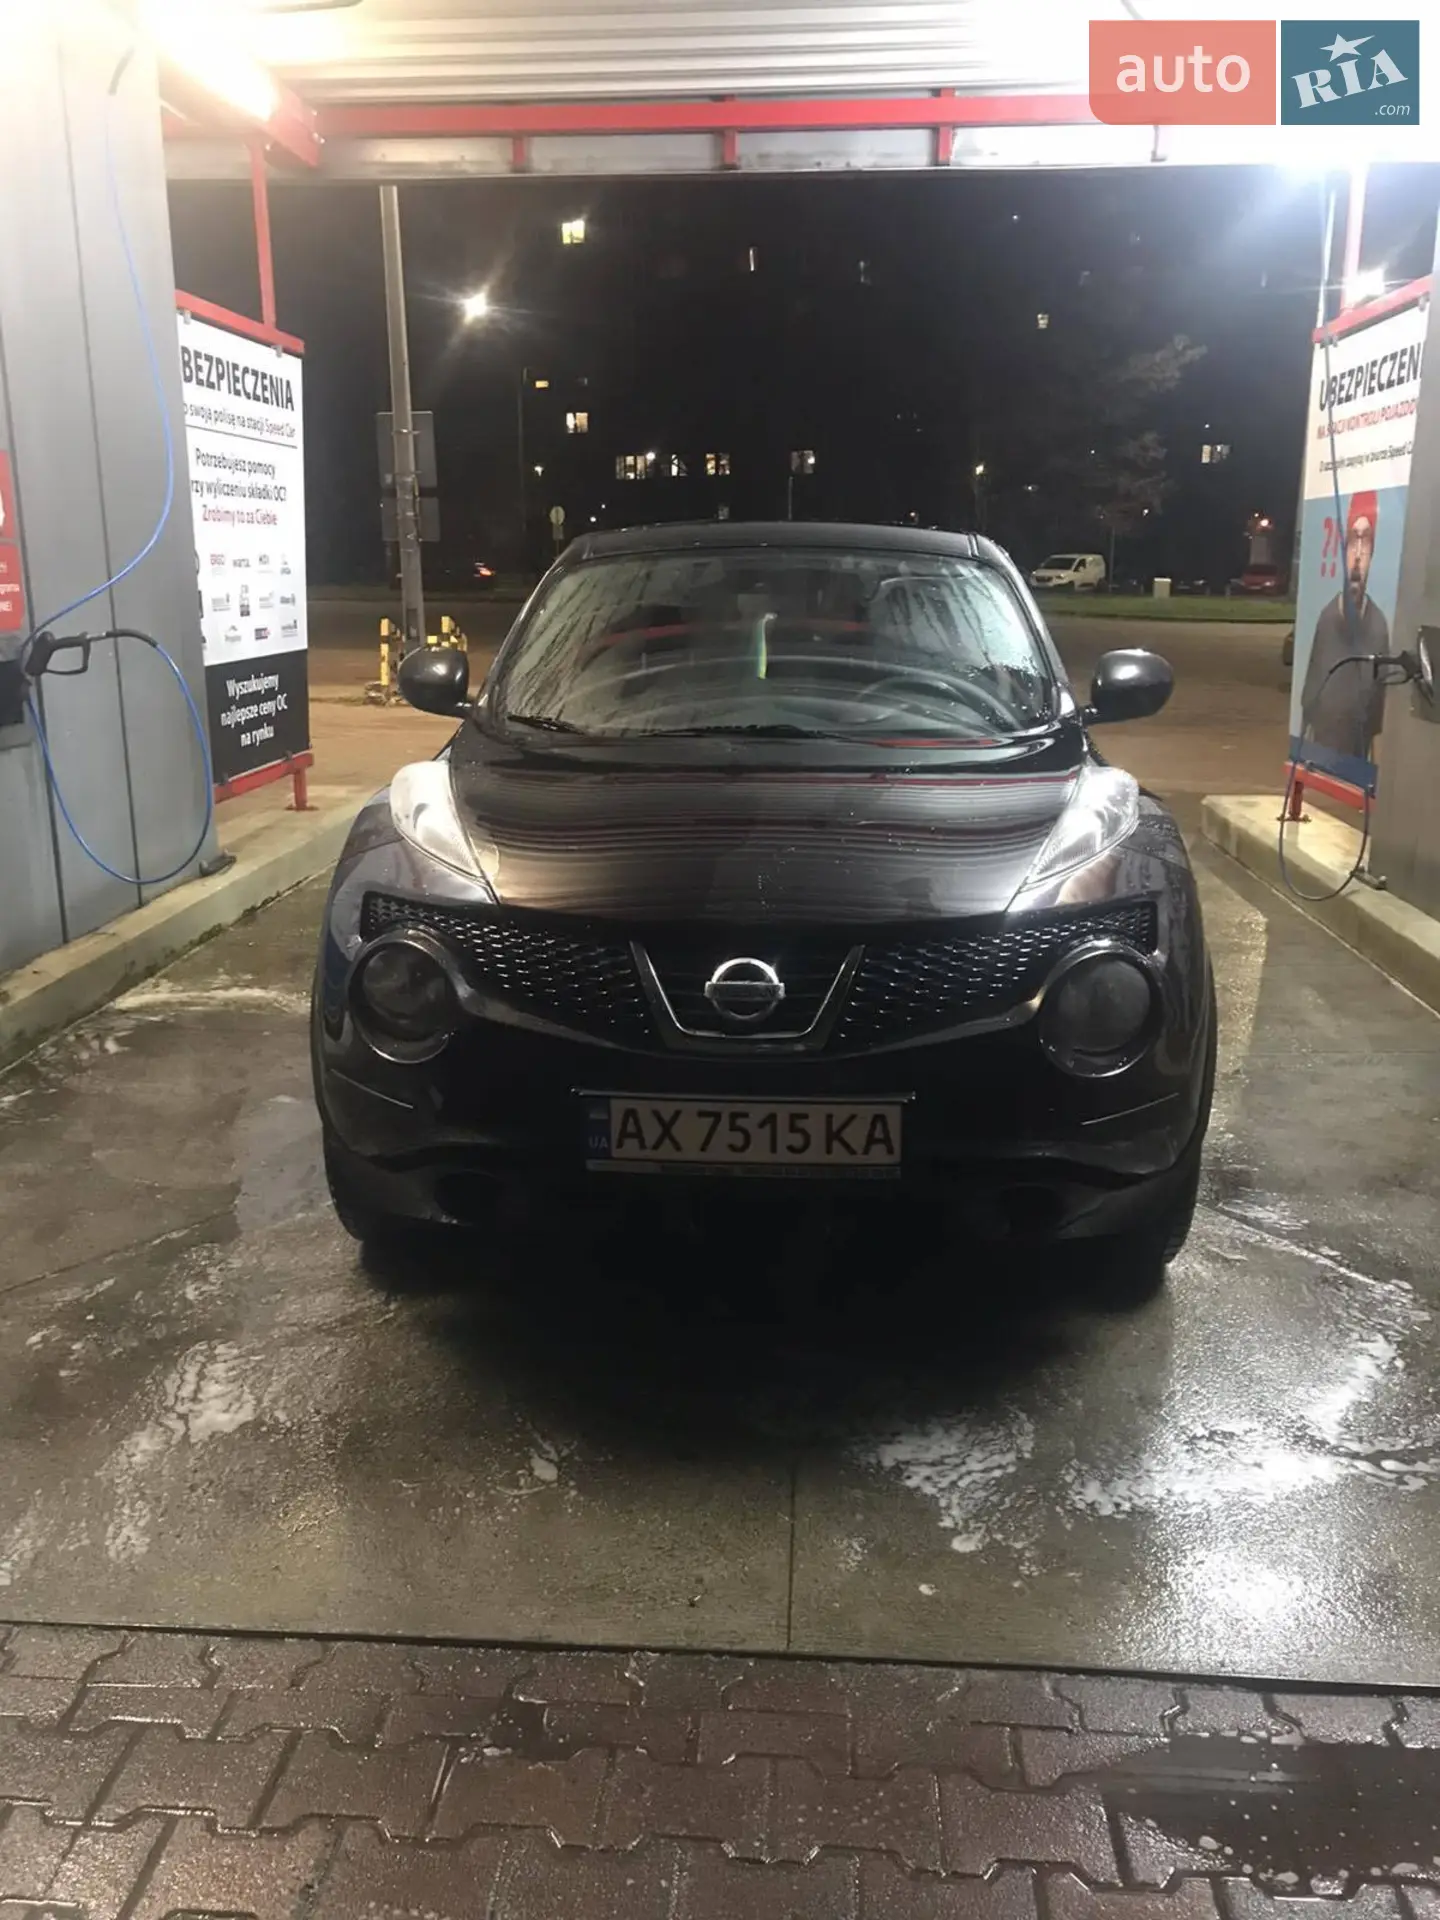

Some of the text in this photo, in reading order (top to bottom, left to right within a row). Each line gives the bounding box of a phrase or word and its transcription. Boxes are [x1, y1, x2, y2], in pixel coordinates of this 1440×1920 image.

[181, 346, 295, 411] BEZPIECZENIA
[195, 447, 276, 480] Potrzebujesz pomocy
[226, 672, 279, 701] Wyszukujemy
[220, 692, 289, 729] najlepsze ceny OC
[240, 722, 275, 747] na rynku
[614, 1107, 896, 1157] AX 7515 KA
